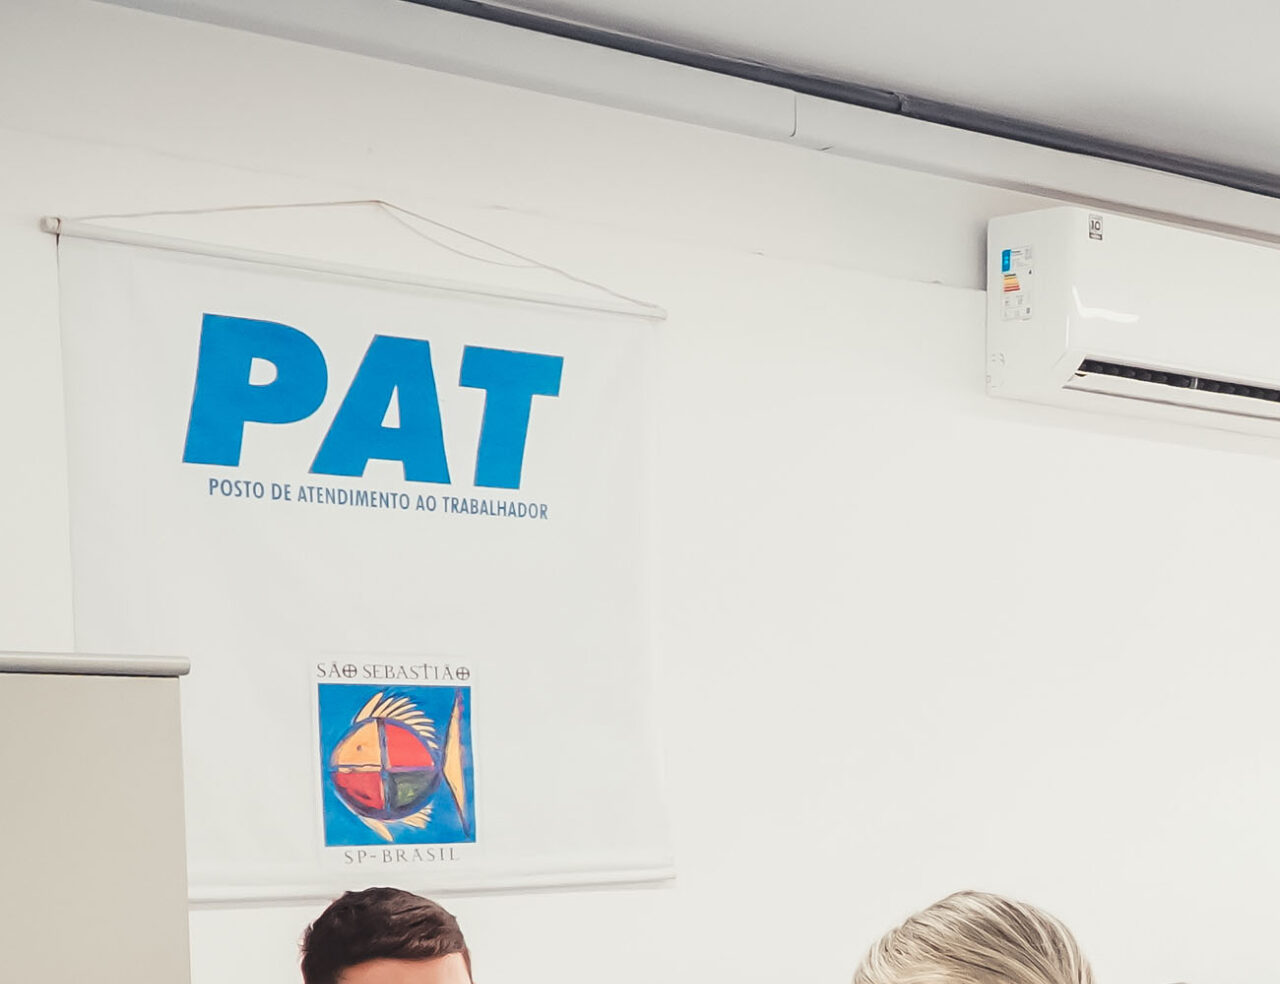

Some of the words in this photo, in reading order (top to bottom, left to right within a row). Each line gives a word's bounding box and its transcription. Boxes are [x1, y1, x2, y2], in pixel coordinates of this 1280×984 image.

[182, 312, 565, 490] PAT
[208, 477, 265, 499] POSTO
[271, 482, 292, 501] DE
[297, 484, 411, 510] ATENDIMENTO
[415, 494, 437, 511] AO
[442, 496, 549, 520] TRABALHADOR
[316, 661, 358, 679] SÃO
[362, 662, 471, 681] SEBASTIÃO
